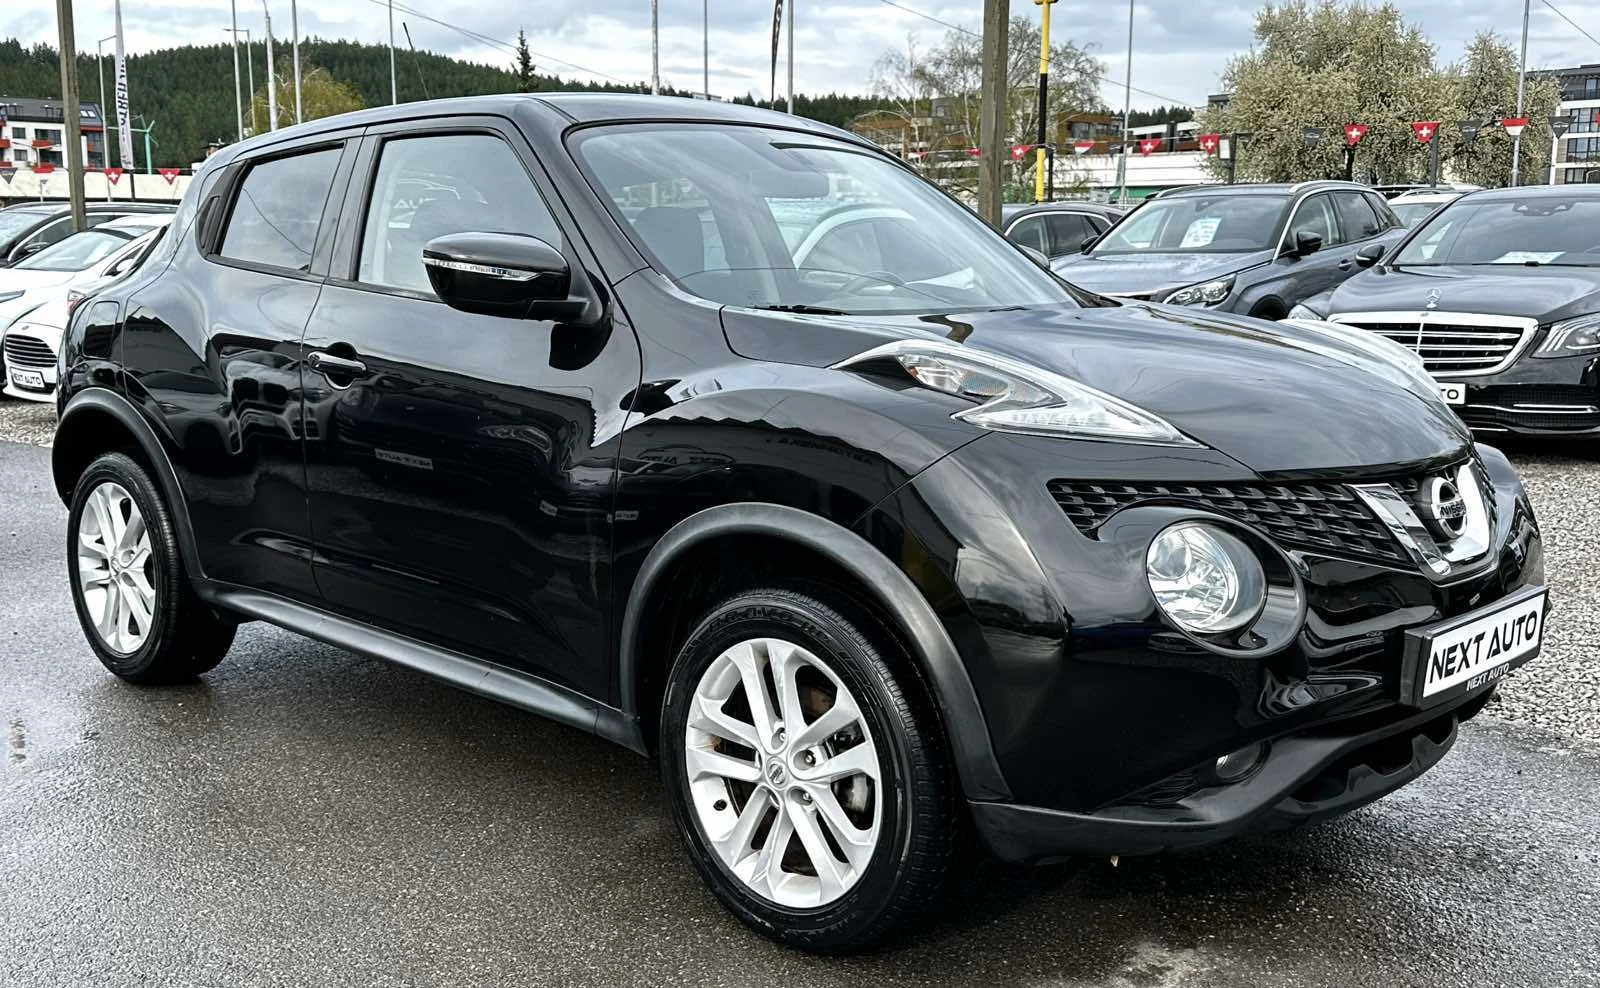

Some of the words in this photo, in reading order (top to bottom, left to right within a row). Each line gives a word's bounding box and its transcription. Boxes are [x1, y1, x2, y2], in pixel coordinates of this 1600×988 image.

[1429, 631, 1486, 684] NEXT
[1486, 610, 1538, 660] AUTO
[1466, 672, 1488, 691] NEXT
[1488, 663, 1509, 681] AUTO
